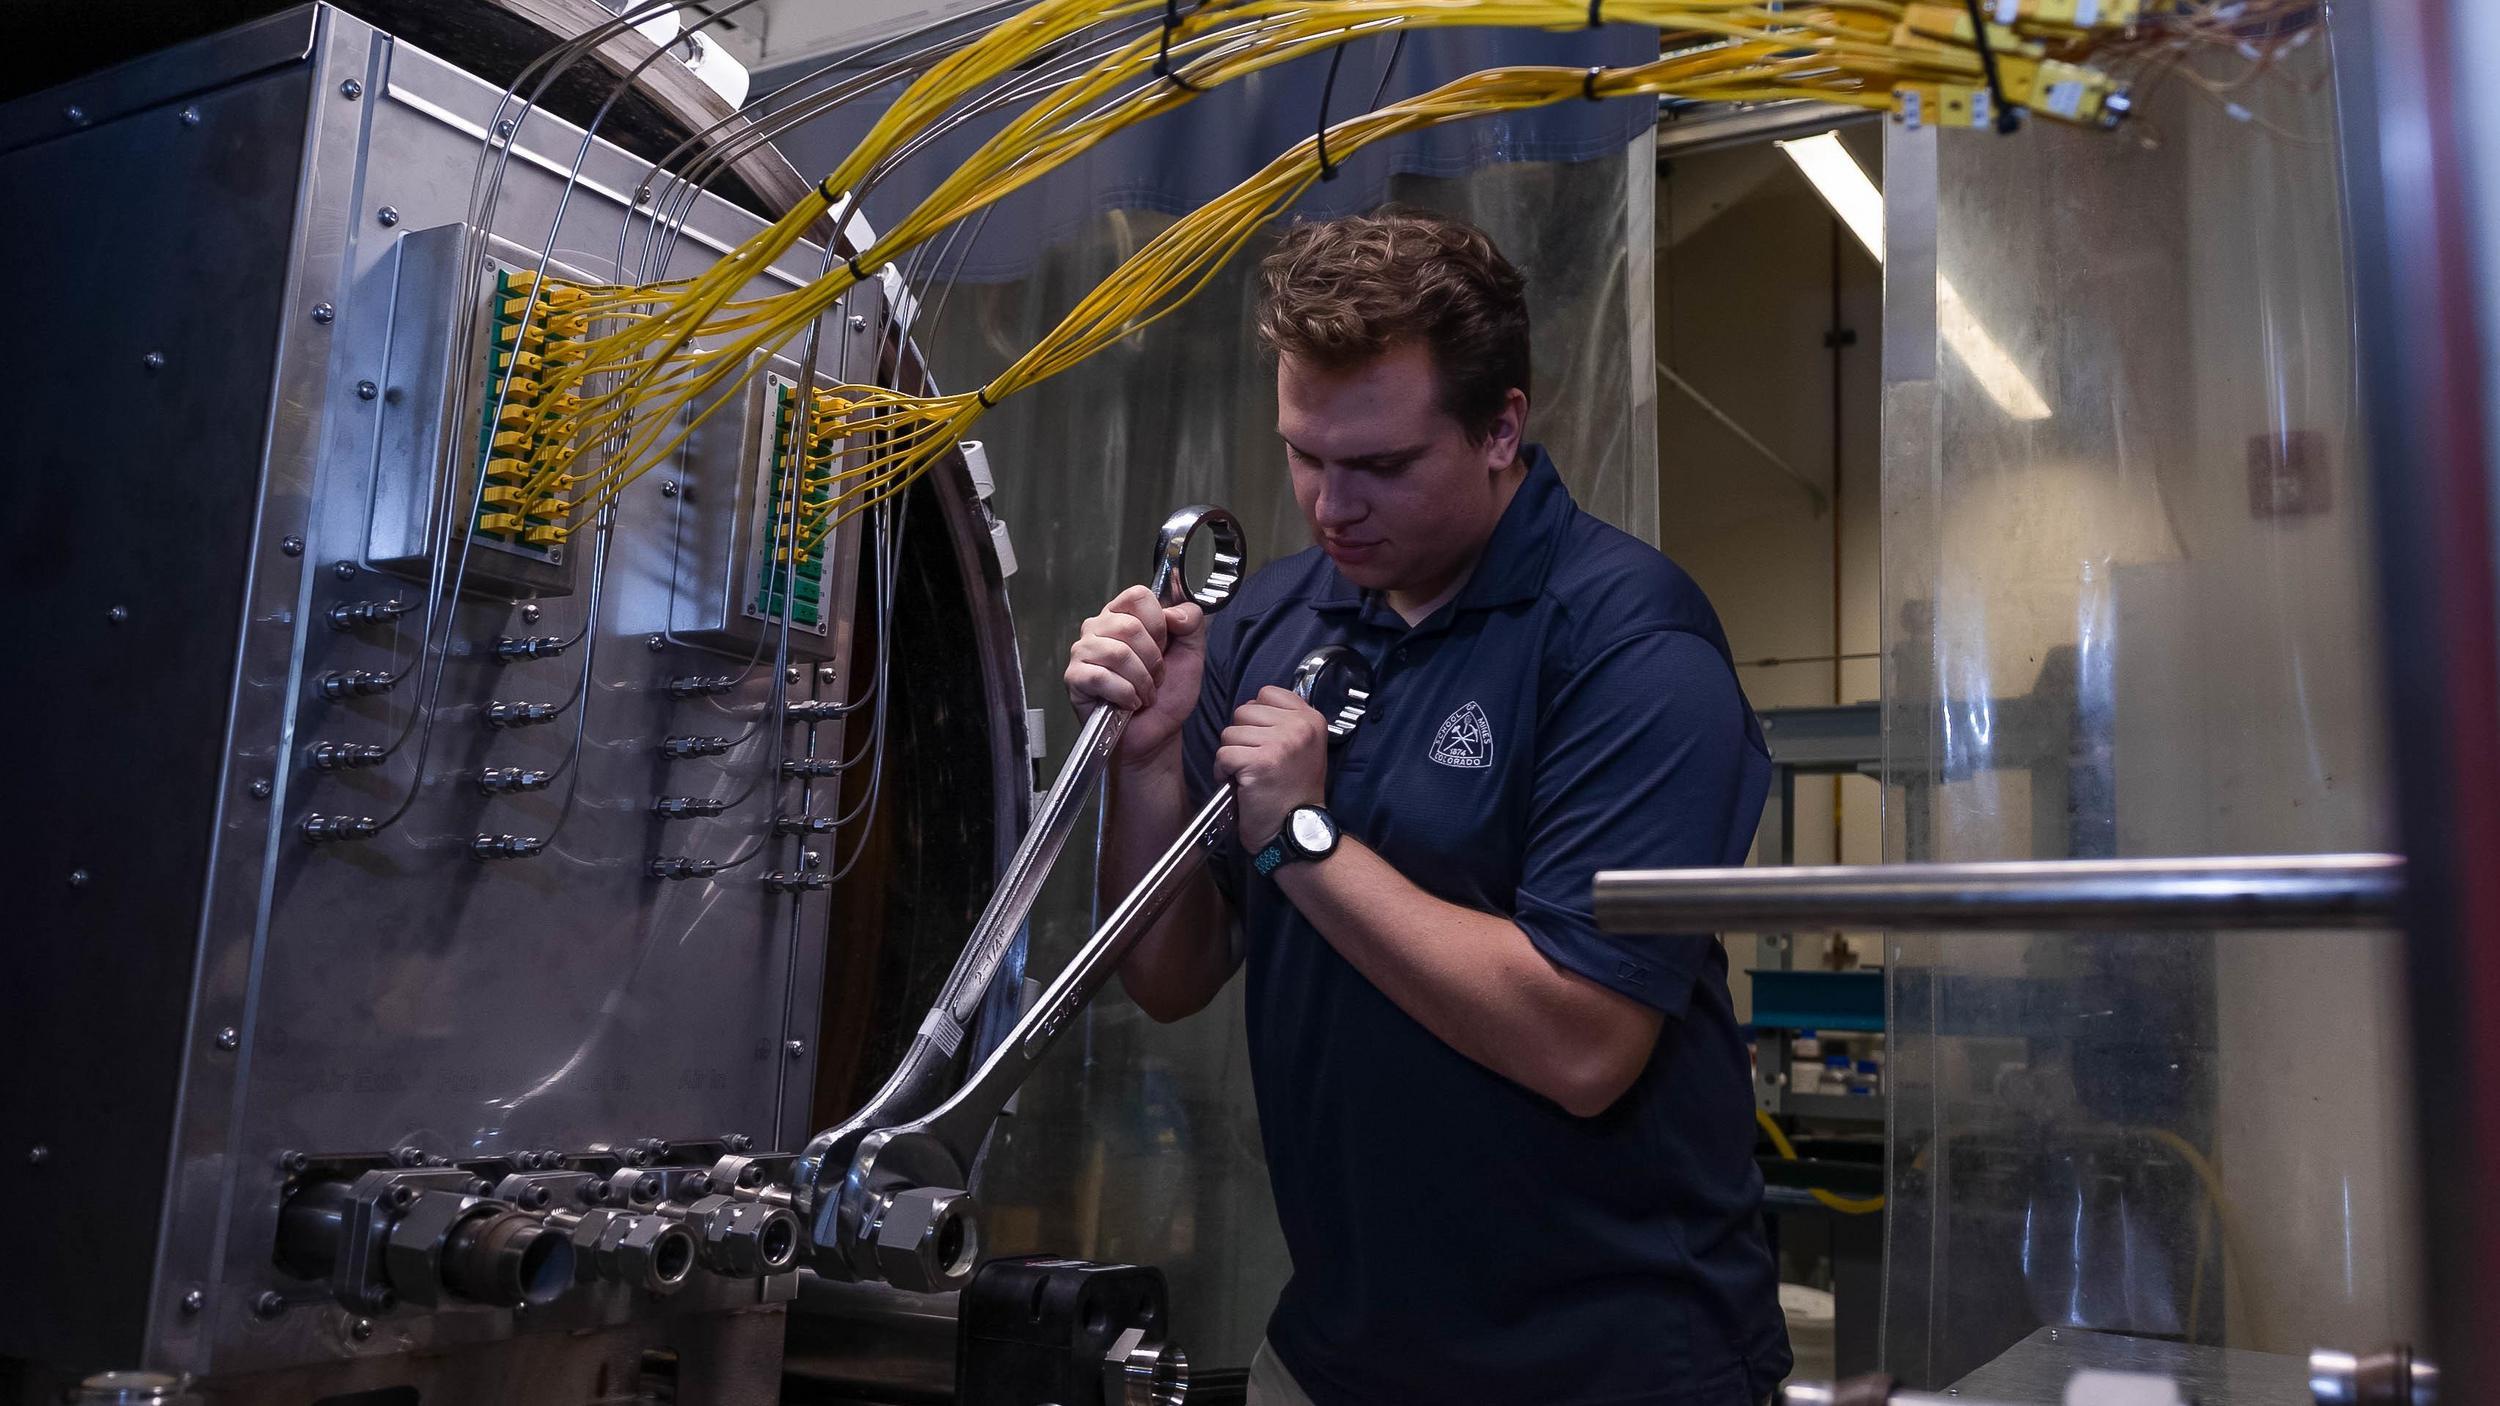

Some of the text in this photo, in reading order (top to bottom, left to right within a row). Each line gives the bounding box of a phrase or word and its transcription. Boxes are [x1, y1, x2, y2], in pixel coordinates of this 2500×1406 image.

[1435, 713, 1462, 744] SCHOOL
[1434, 752, 1481, 766] COLORADO
[1449, 748, 1467, 756] 1874
